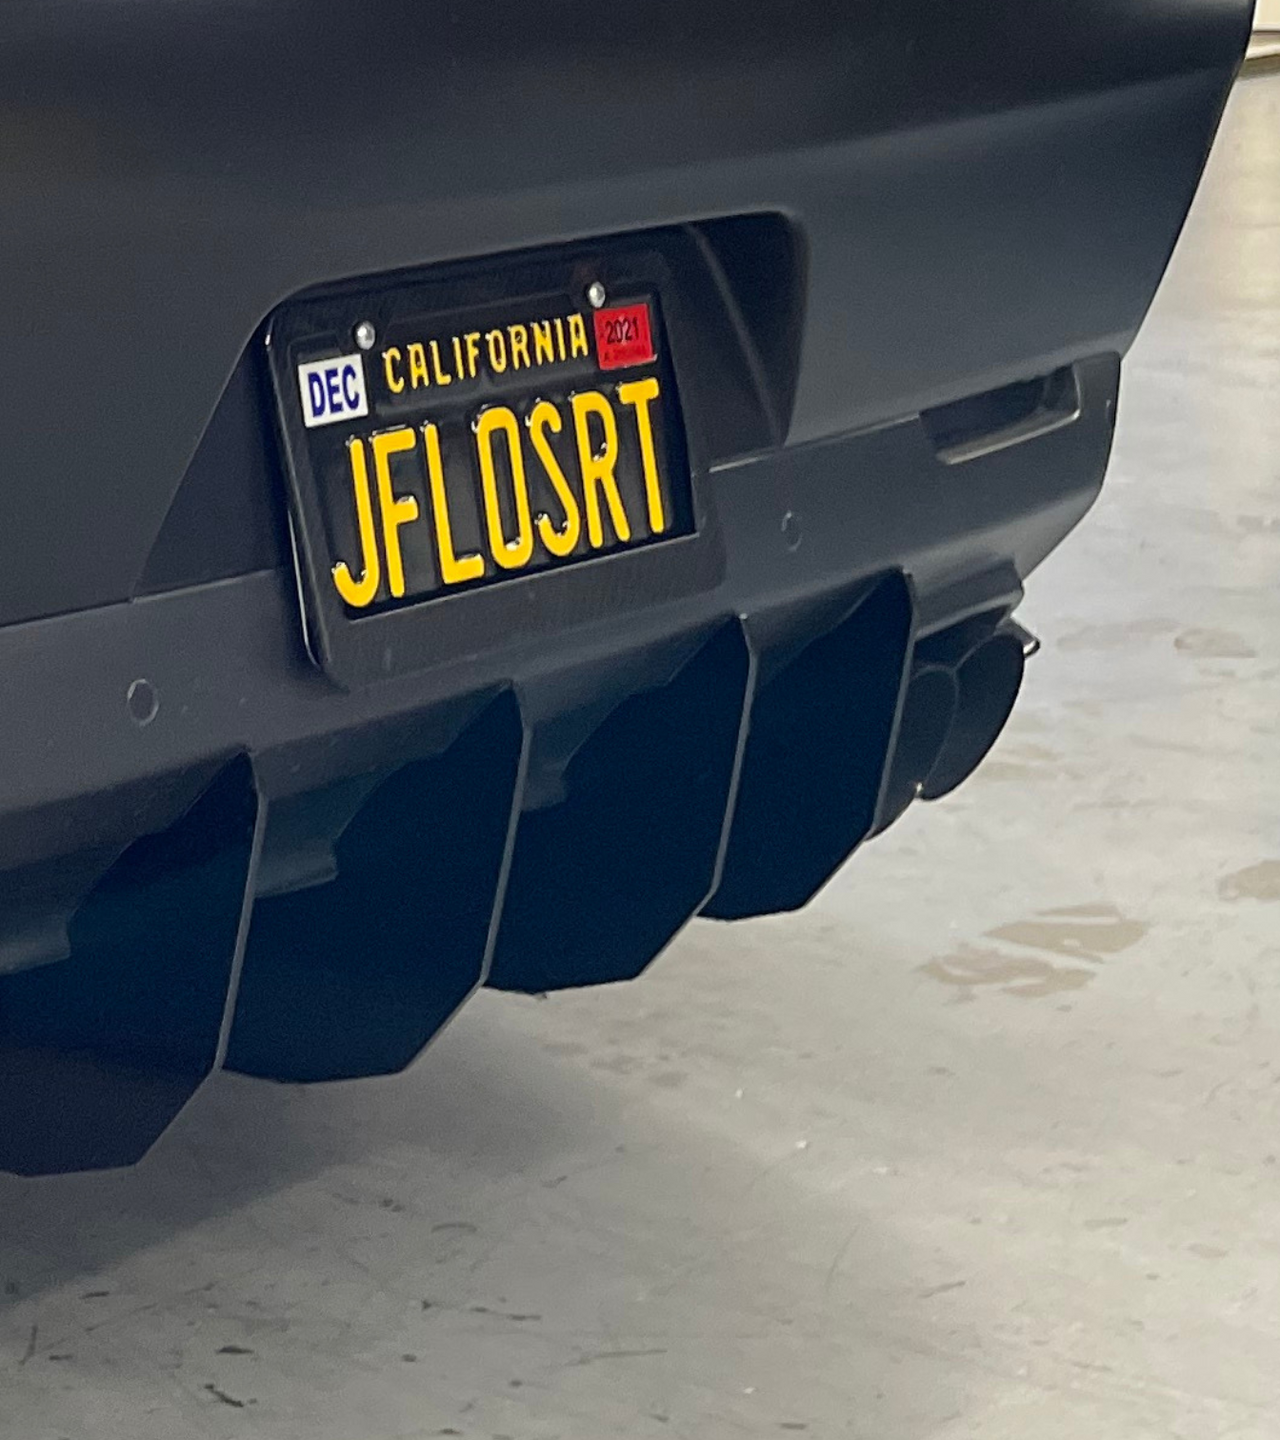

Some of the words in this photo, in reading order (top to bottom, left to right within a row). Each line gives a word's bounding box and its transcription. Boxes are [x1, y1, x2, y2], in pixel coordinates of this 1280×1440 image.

[383, 313, 589, 393] CALIFORNIA
[604, 316, 640, 345] 2021
[308, 364, 361, 417] DEC
[332, 377, 665, 607] JFLOSRT
